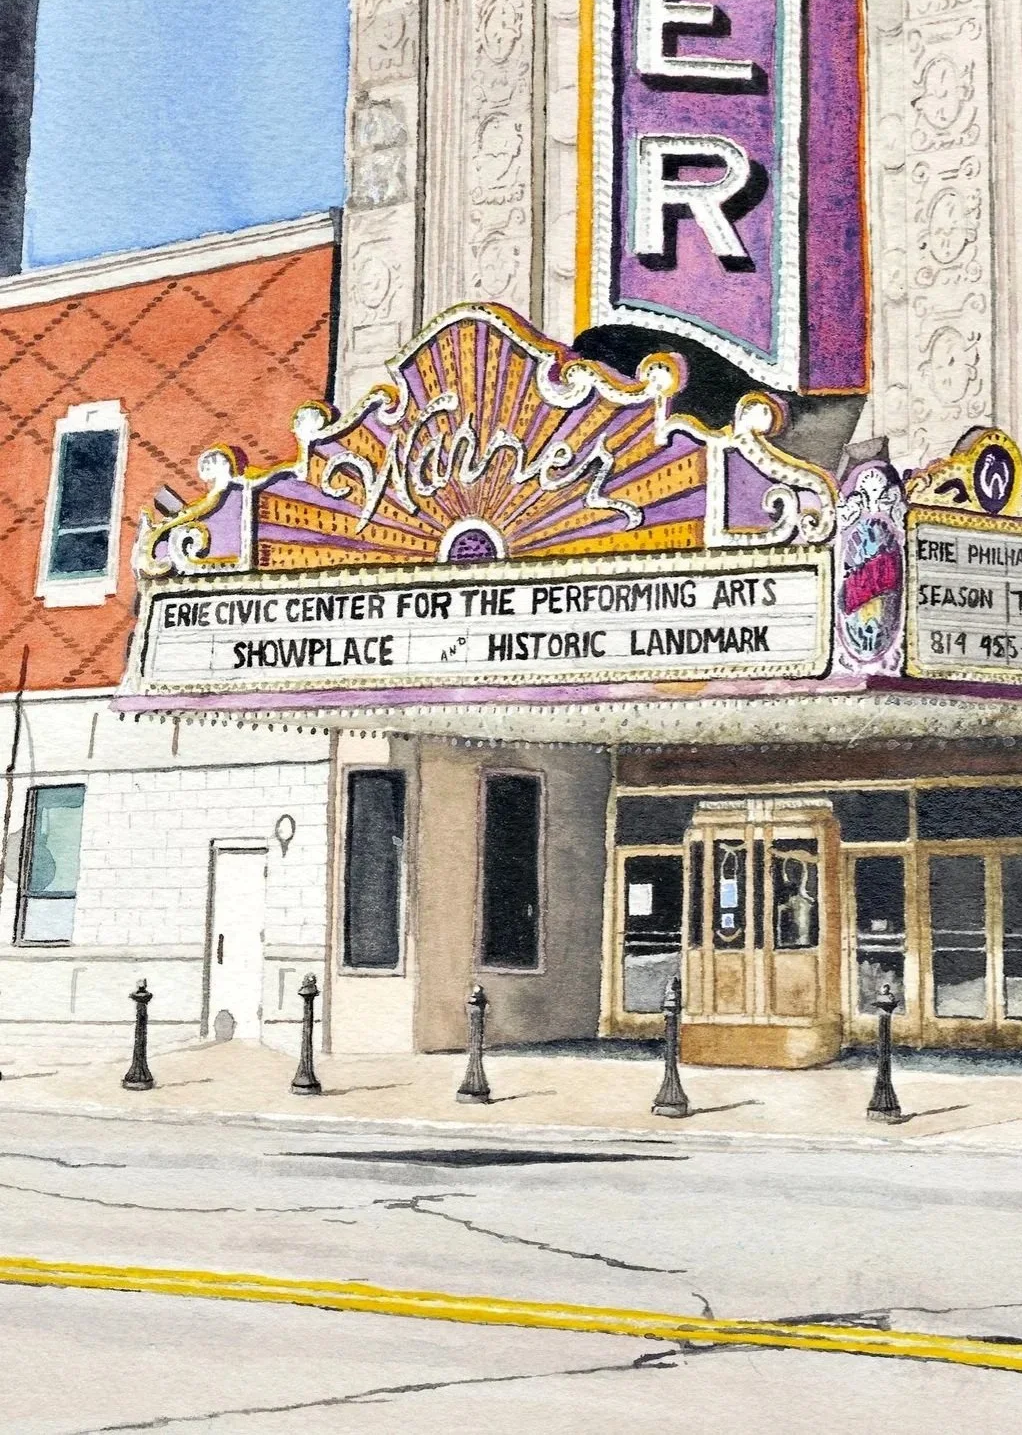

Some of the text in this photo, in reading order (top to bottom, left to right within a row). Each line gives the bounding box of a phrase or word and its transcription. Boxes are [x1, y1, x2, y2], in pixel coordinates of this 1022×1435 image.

[917, 539, 957, 563] ERIE
[164, 577, 777, 628] ERIE CIVIC CENTER FOR THE PERFORMING ARTS
[918, 584, 994, 609] SEASON
[233, 626, 770, 669] SHOWPLACE AND HISTORIC LANDMARK
[930, 630, 968, 655] 814
